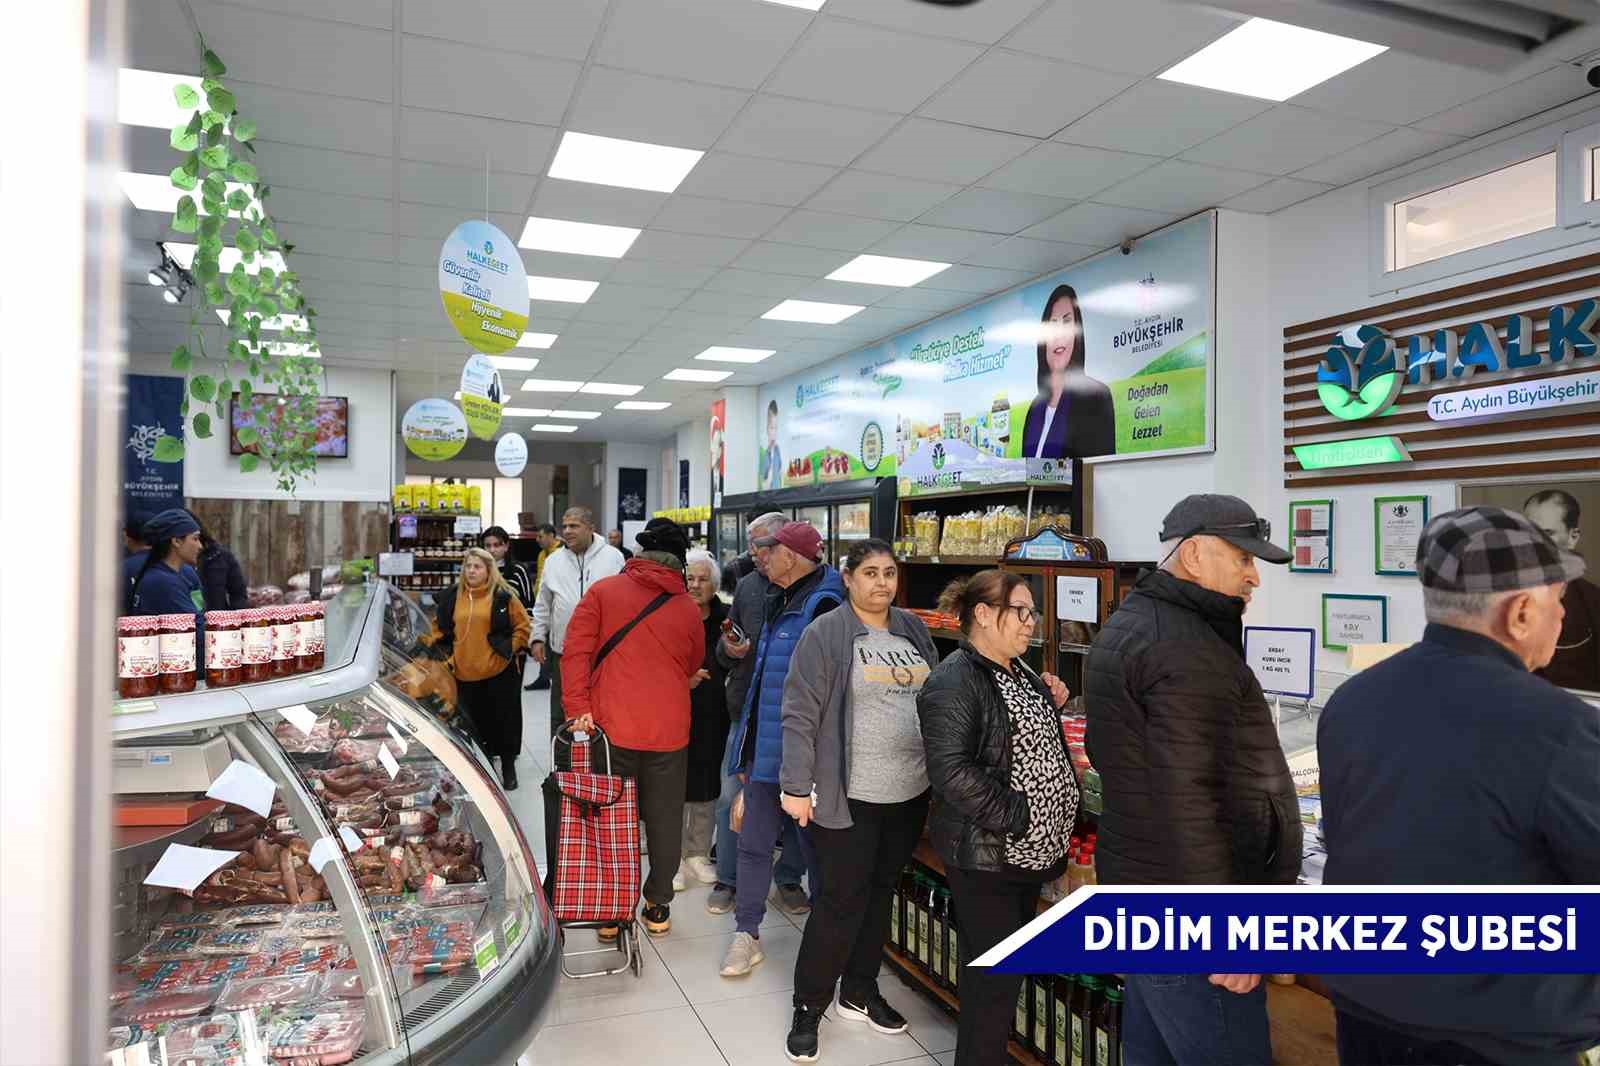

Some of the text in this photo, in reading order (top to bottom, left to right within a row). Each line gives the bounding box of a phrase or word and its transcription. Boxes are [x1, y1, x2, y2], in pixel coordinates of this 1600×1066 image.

[952, 325, 985, 357] Destek
[1113, 316, 1184, 349] BÜYÜKŞEHİR
[1408, 298, 1599, 386] HALK
[1127, 382, 1169, 403] Doğadan
[1432, 378, 1600, 415] T.C. Aydın Büyükşehir
[1134, 405, 1161, 421] Gelen
[1132, 423, 1163, 441] Lezzet
[124, 482, 179, 492] BÜYÜKŞEHİR
